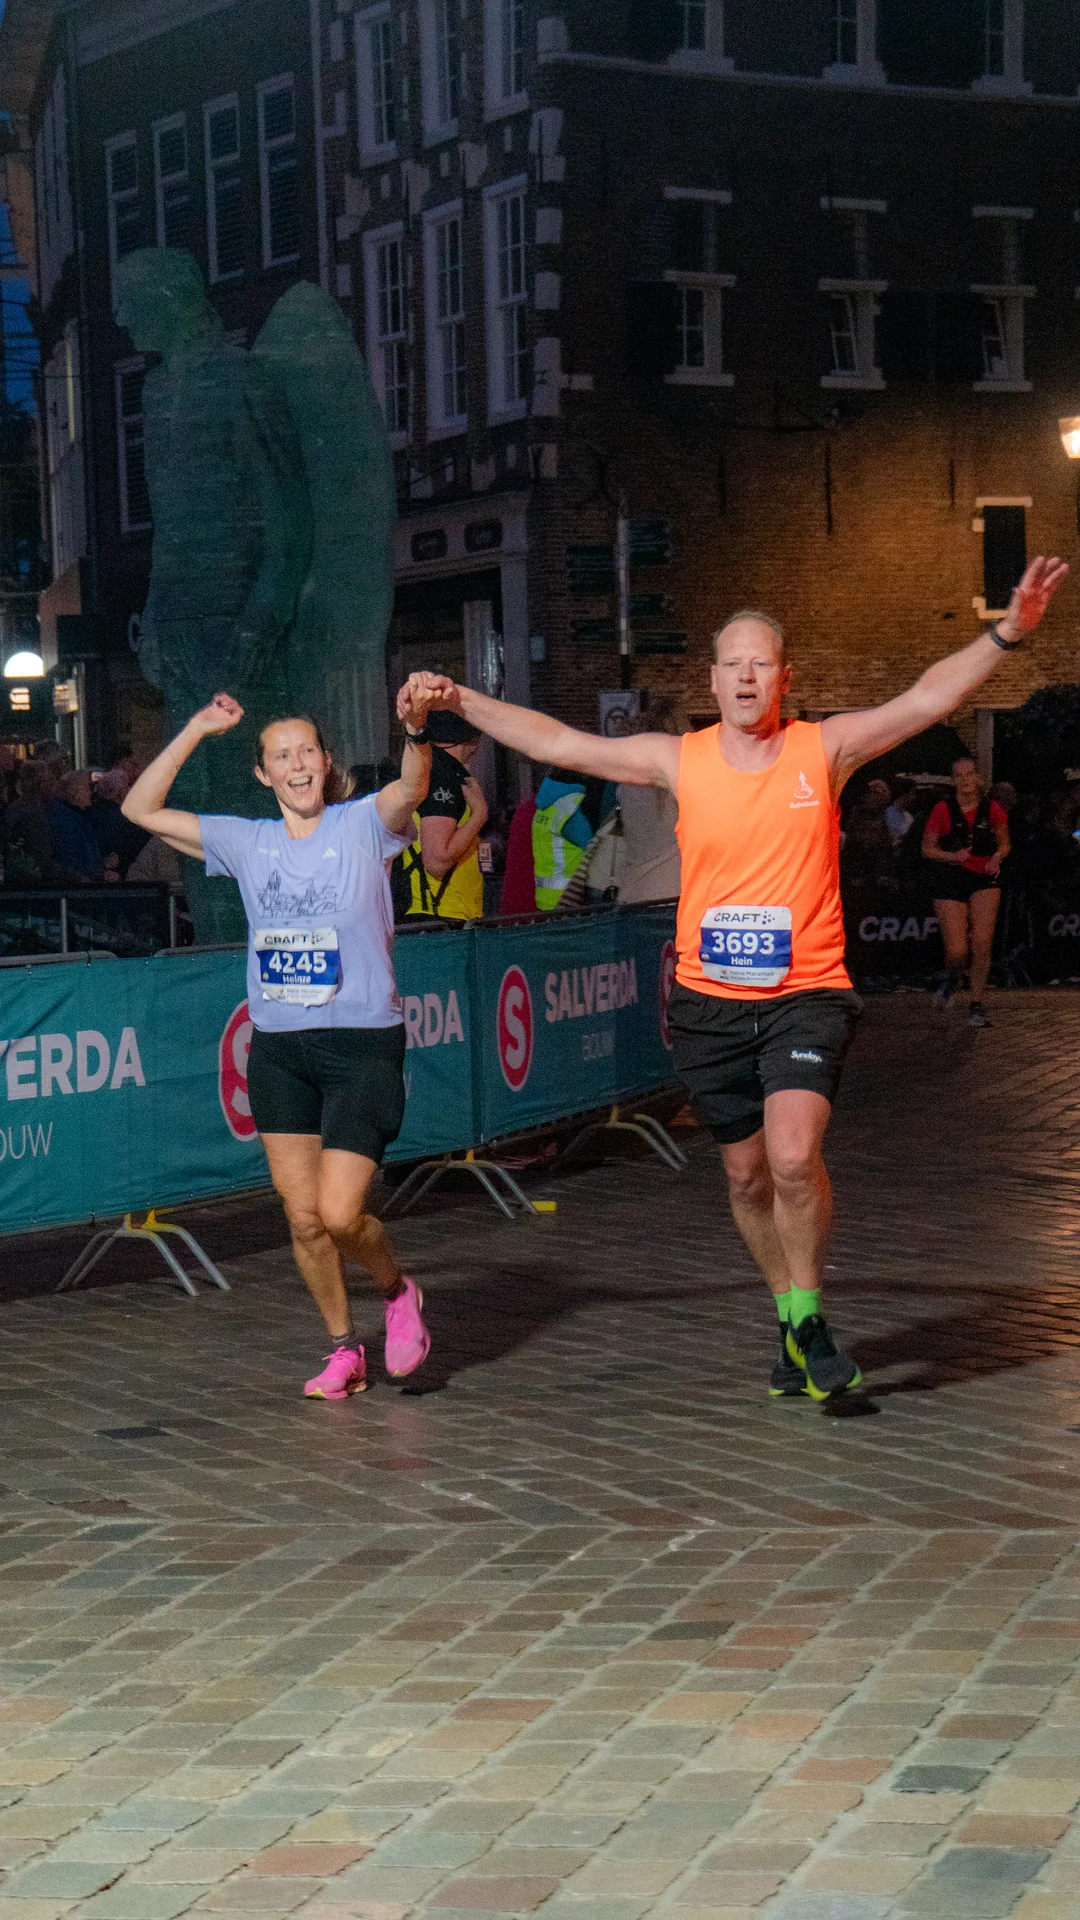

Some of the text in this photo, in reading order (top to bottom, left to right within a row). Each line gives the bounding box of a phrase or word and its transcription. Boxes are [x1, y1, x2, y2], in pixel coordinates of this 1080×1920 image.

[713, 912, 761, 923] CRAFT
[858, 915, 940, 942] CRAF
[1048, 913, 1080, 938] CR
[264, 932, 310, 945] CRAFT
[711, 931, 775, 956] 3693
[268, 951, 328, 975] 4245
[730, 956, 753, 966] Hein
[282, 973, 312, 985] Heinze
[544, 957, 639, 1024] SALVERDA
[400, 990, 466, 1050] RDA
